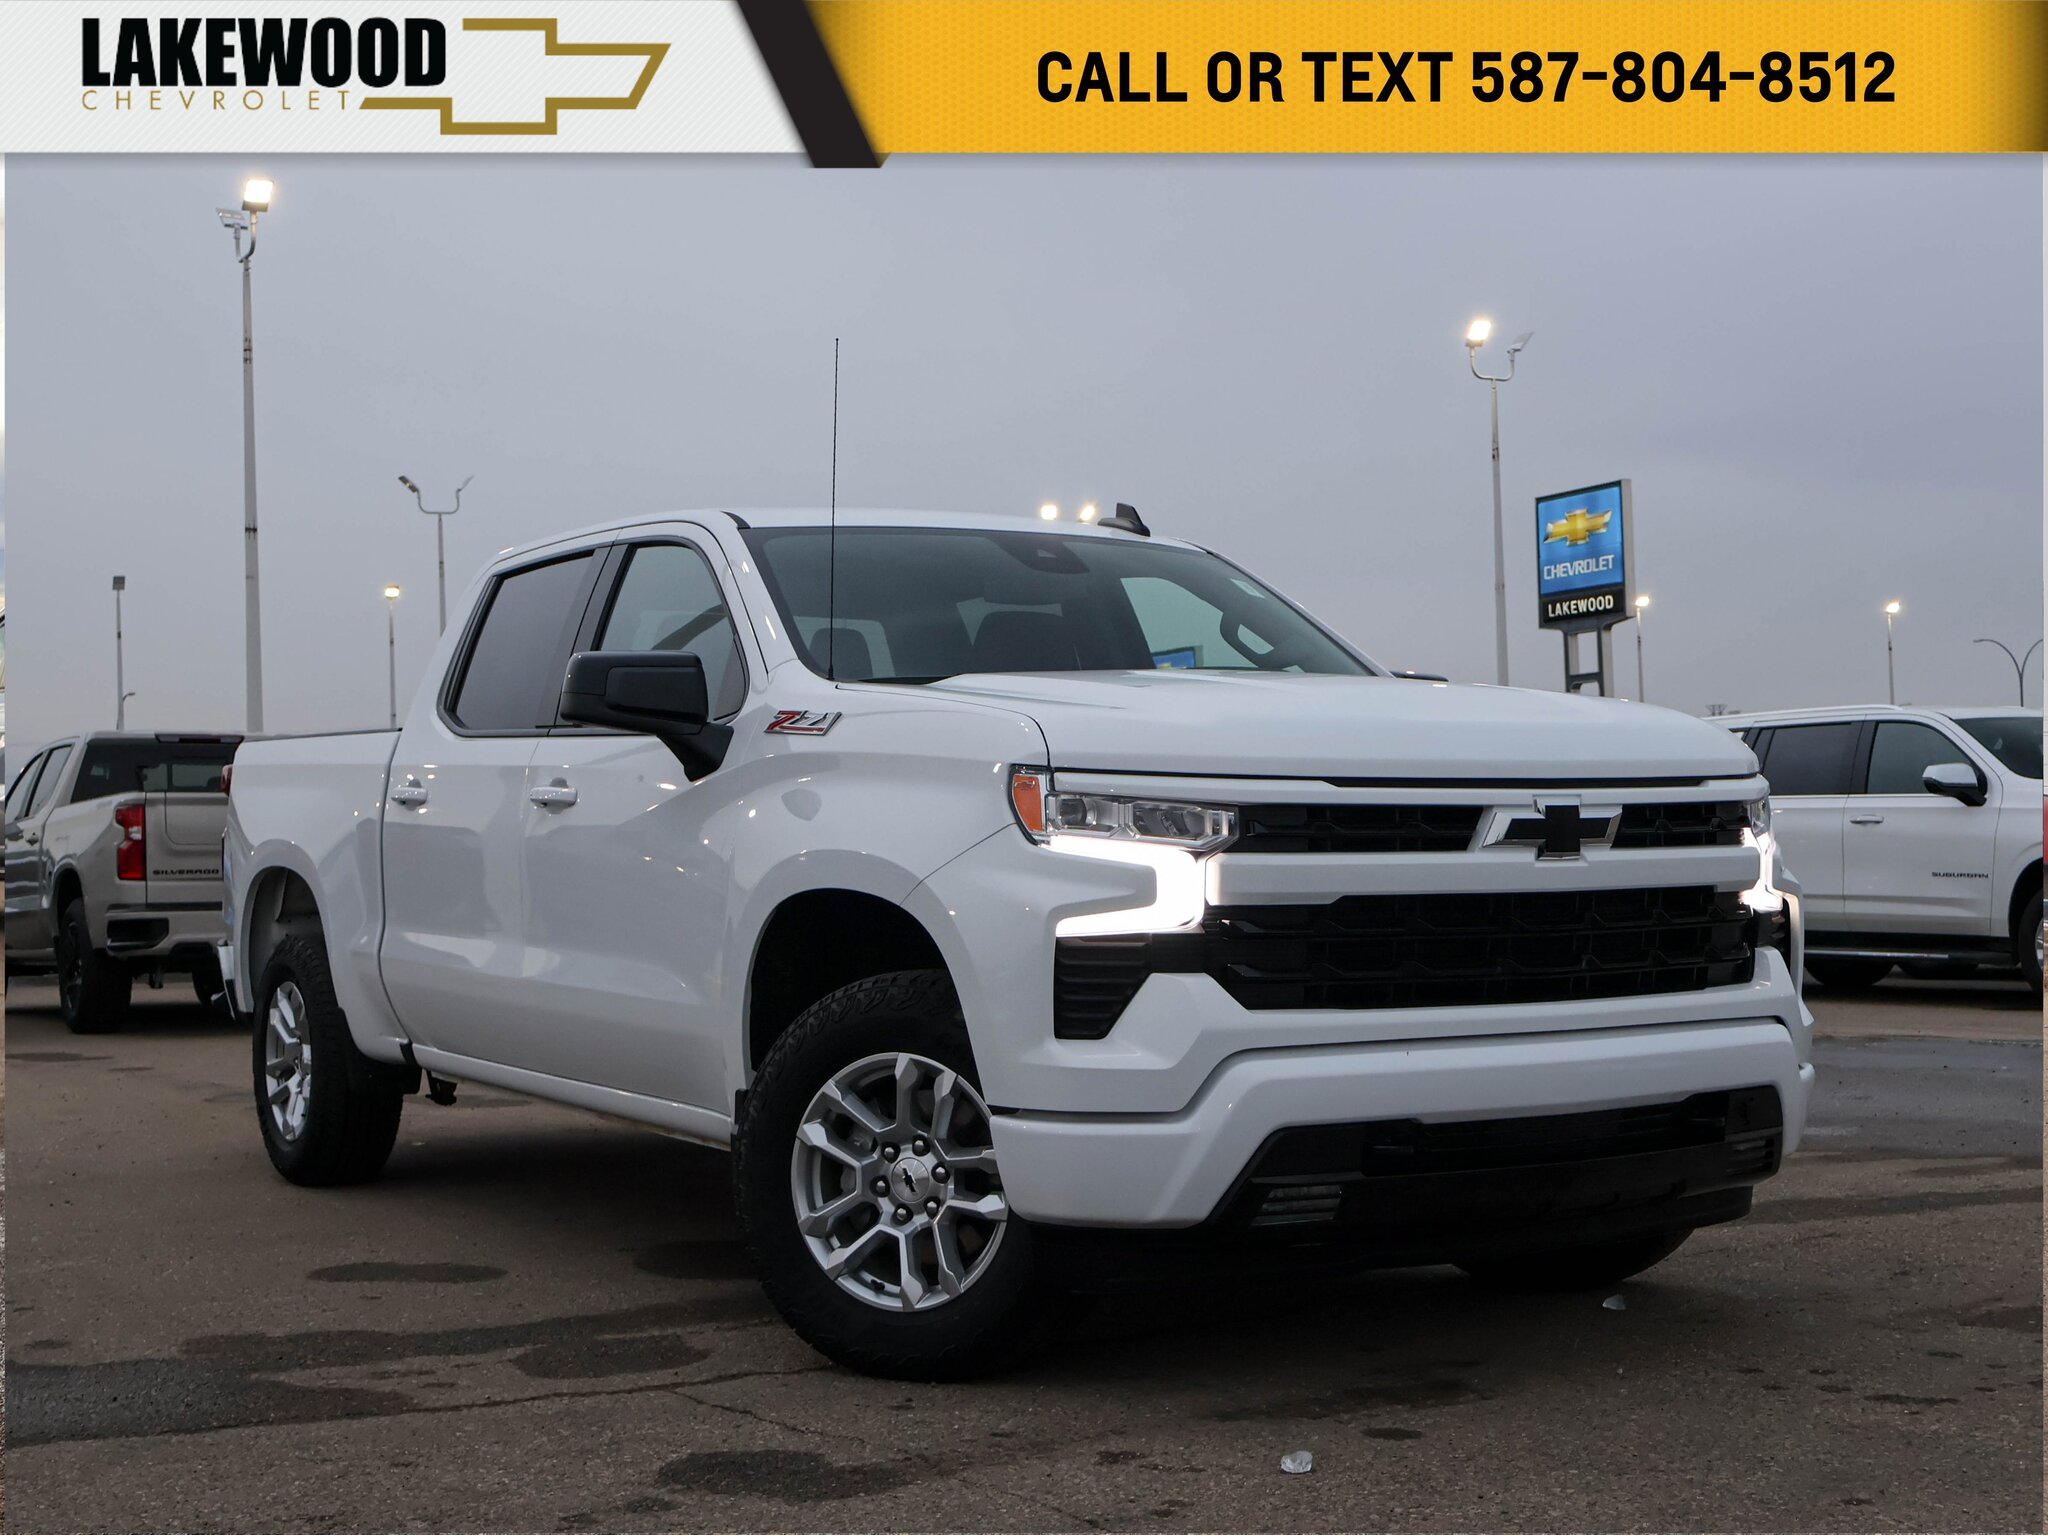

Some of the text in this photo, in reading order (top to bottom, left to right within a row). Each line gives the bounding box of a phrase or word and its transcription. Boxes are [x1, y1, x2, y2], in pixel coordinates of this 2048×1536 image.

[1543, 554, 1615, 580] CHEVROLET
[1548, 595, 1614, 617] LAKEWOOD
[764, 710, 842, 736] Z71
[152, 868, 220, 876] SILVERADO
[1931, 871, 1989, 879] SUBURBAN
